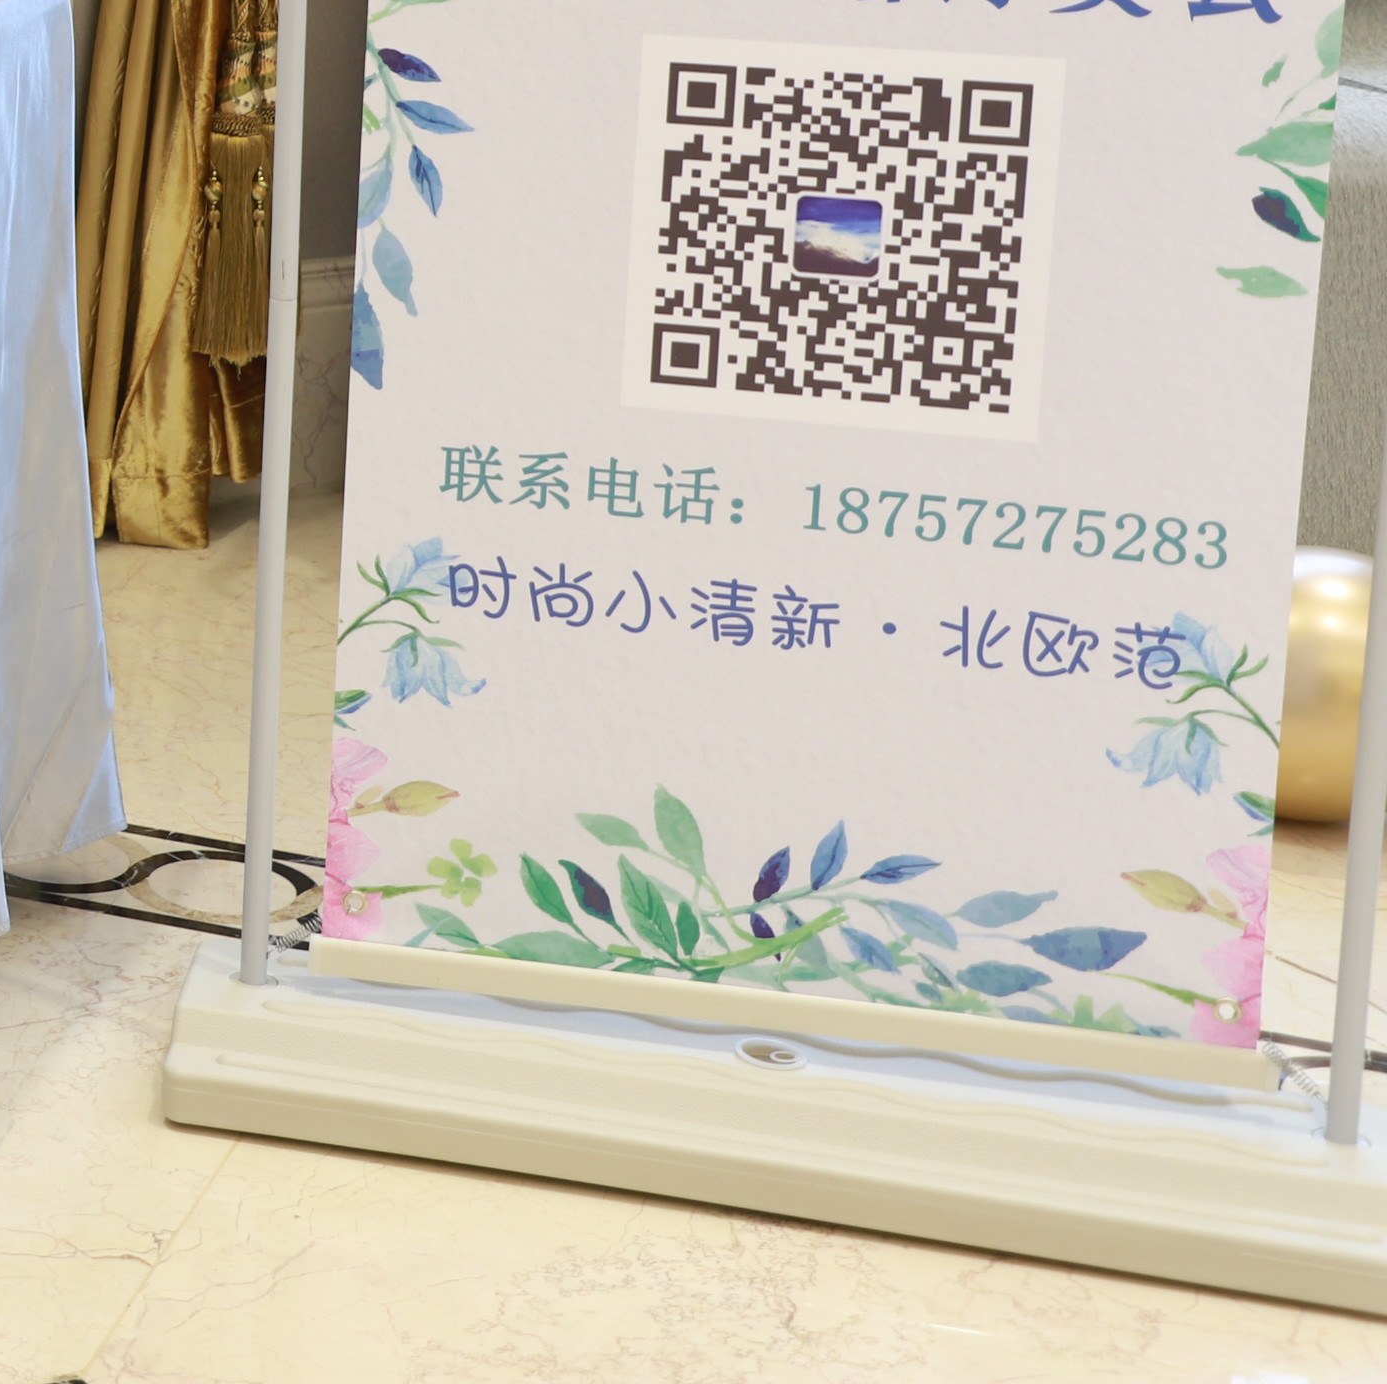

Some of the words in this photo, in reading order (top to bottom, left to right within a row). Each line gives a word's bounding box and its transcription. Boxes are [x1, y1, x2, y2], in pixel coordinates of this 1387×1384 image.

[438, 444, 746, 527] 联系电话：
[802, 482, 1230, 570] 18757275283
